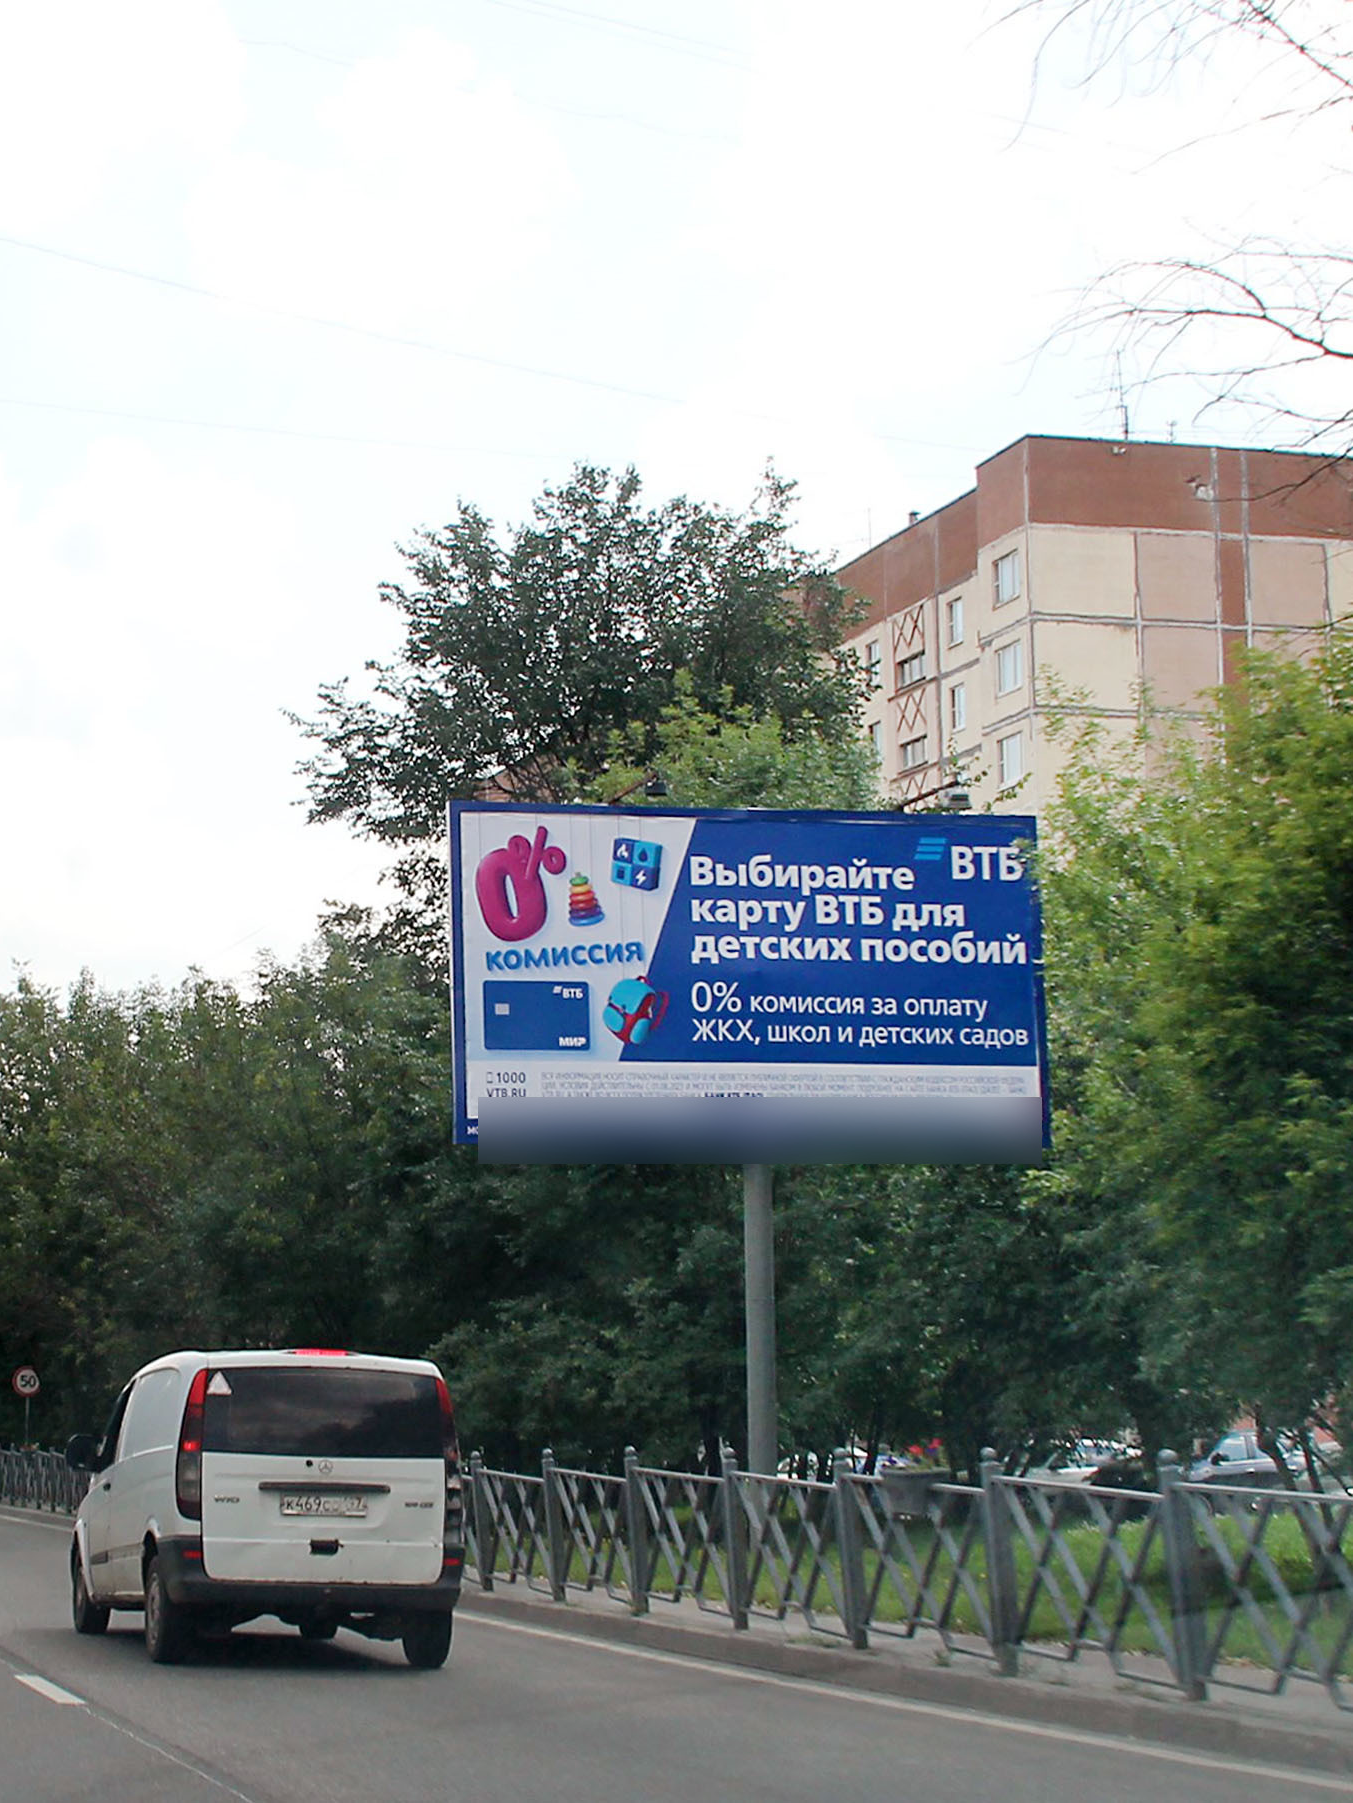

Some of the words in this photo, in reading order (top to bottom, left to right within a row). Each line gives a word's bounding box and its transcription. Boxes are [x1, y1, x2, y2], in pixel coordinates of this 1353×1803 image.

[690, 854, 916, 896] Выбирайте
[950, 845, 1024, 881] ВТБ
[475, 825, 567, 942] 0%
[691, 898, 806, 932] карту
[815, 894, 884, 926] ВТБ
[892, 903, 966, 932] для
[485, 941, 645, 972] КОМИССИЯ
[691, 935, 852, 964] детских
[860, 930, 1027, 964] пособий
[562, 988, 584, 999] ВТБ
[691, 981, 742, 1013] 0%
[750, 995, 865, 1015] комиссия
[871, 997, 897, 1015] за
[904, 998, 988, 1023] оплату
[692, 1019, 760, 1045] ЖКХ,
[767, 1025, 830, 1043] школ
[838, 1027, 853, 1043] и
[859, 1026, 954, 1047] детских
[959, 1028, 1029, 1049] садов
[487, 1088, 526, 1098] VTBRU
[497, 1072, 526, 1083] 1000
[20, 1375, 37, 1388] 50
